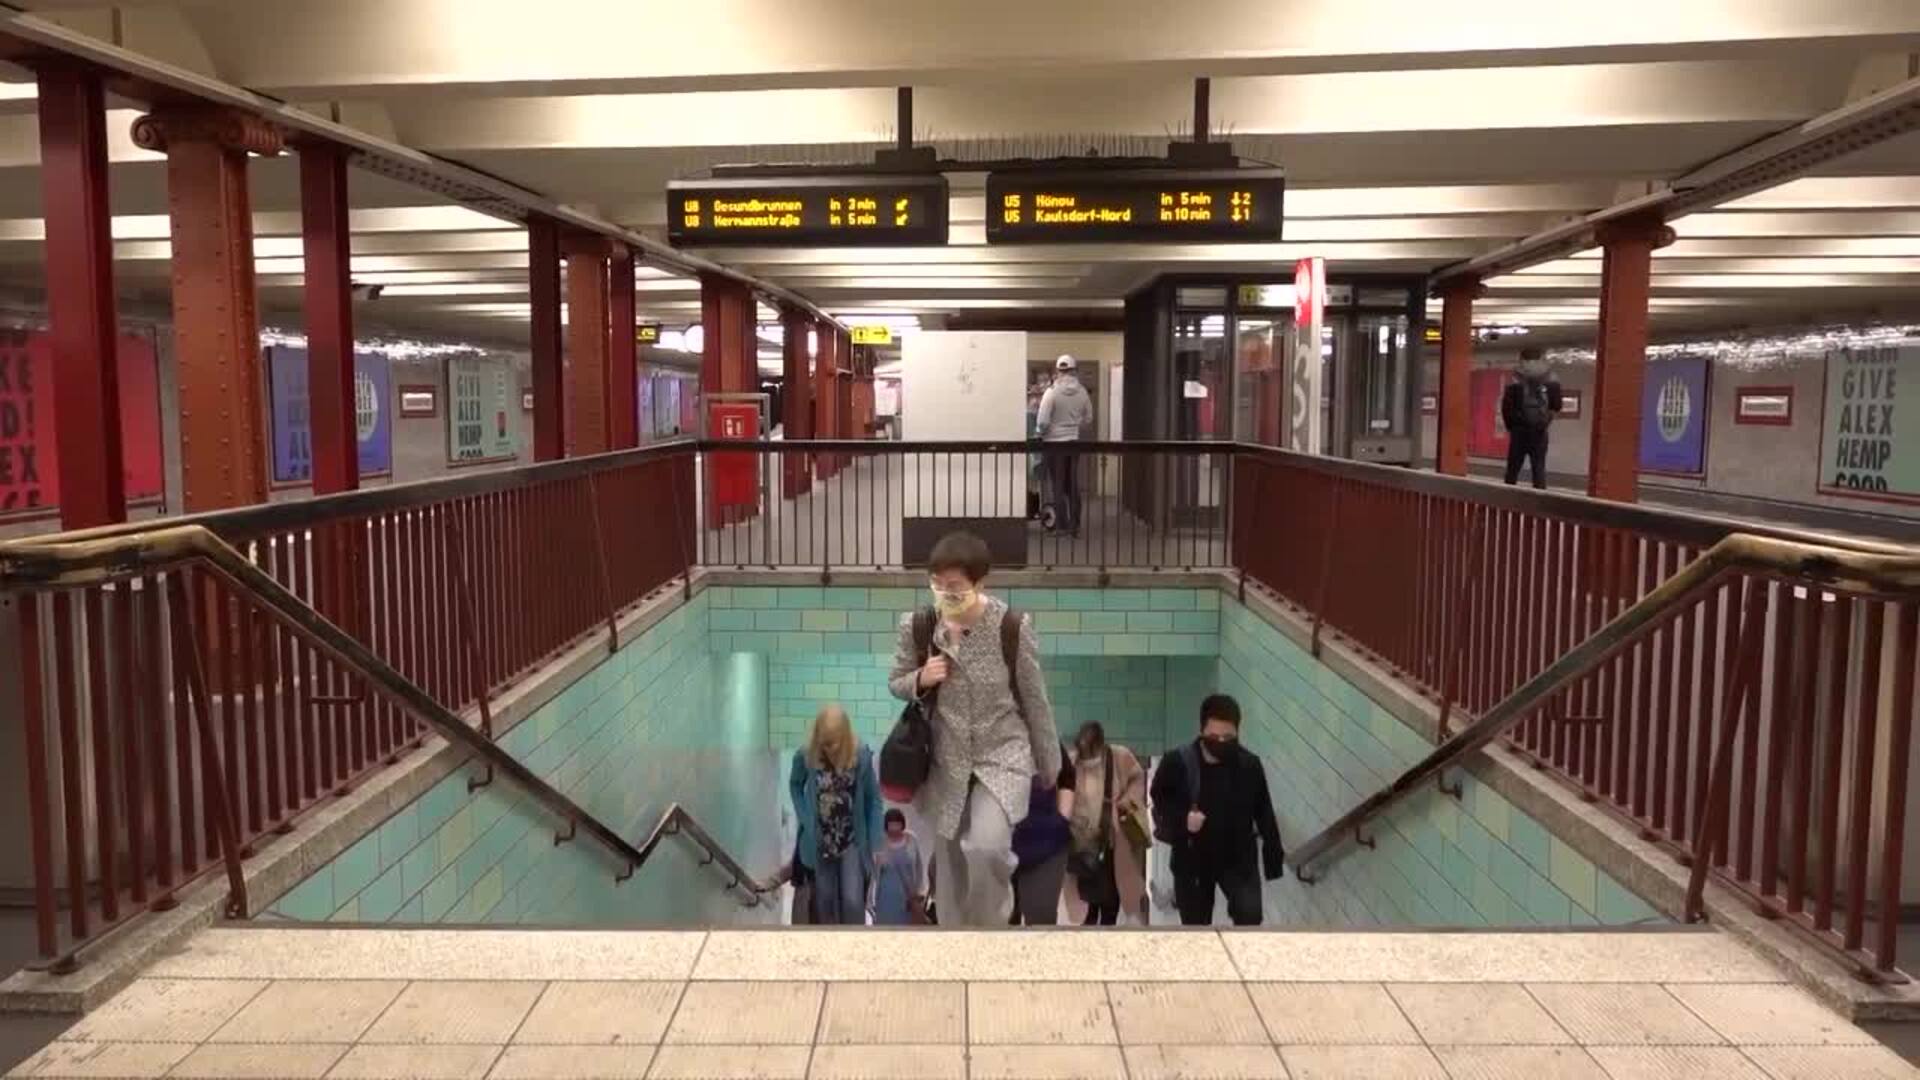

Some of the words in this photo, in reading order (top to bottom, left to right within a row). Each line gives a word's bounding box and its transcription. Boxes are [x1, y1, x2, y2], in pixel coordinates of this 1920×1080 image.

[713, 200, 803, 213] Gesundbrunnen
[830, 199, 841, 211] in
[848, 199, 856, 211] 3
[857, 199, 877, 211] min
[1004, 195, 1020, 208] U5
[1160, 192, 1173, 205] in
[1180, 192, 1189, 205] 5
[1190, 192, 1211, 205] min
[713, 215, 802, 228] Hermannstraße
[830, 214, 841, 226] in
[857, 214, 877, 226] min
[1004, 210, 1020, 223] U5
[1035, 208, 1131, 222] Kaulsdorf-Nord
[1160, 208, 1172, 221] in
[1175, 208, 1187, 221] 10
[1190, 208, 1211, 221] min
[457, 374, 481, 397] GIVE
[1842, 368, 1897, 399] GIVE
[457, 399, 482, 421] ALEX
[1839, 403, 1894, 435] ALEX
[1836, 437, 1892, 471] HEMP
